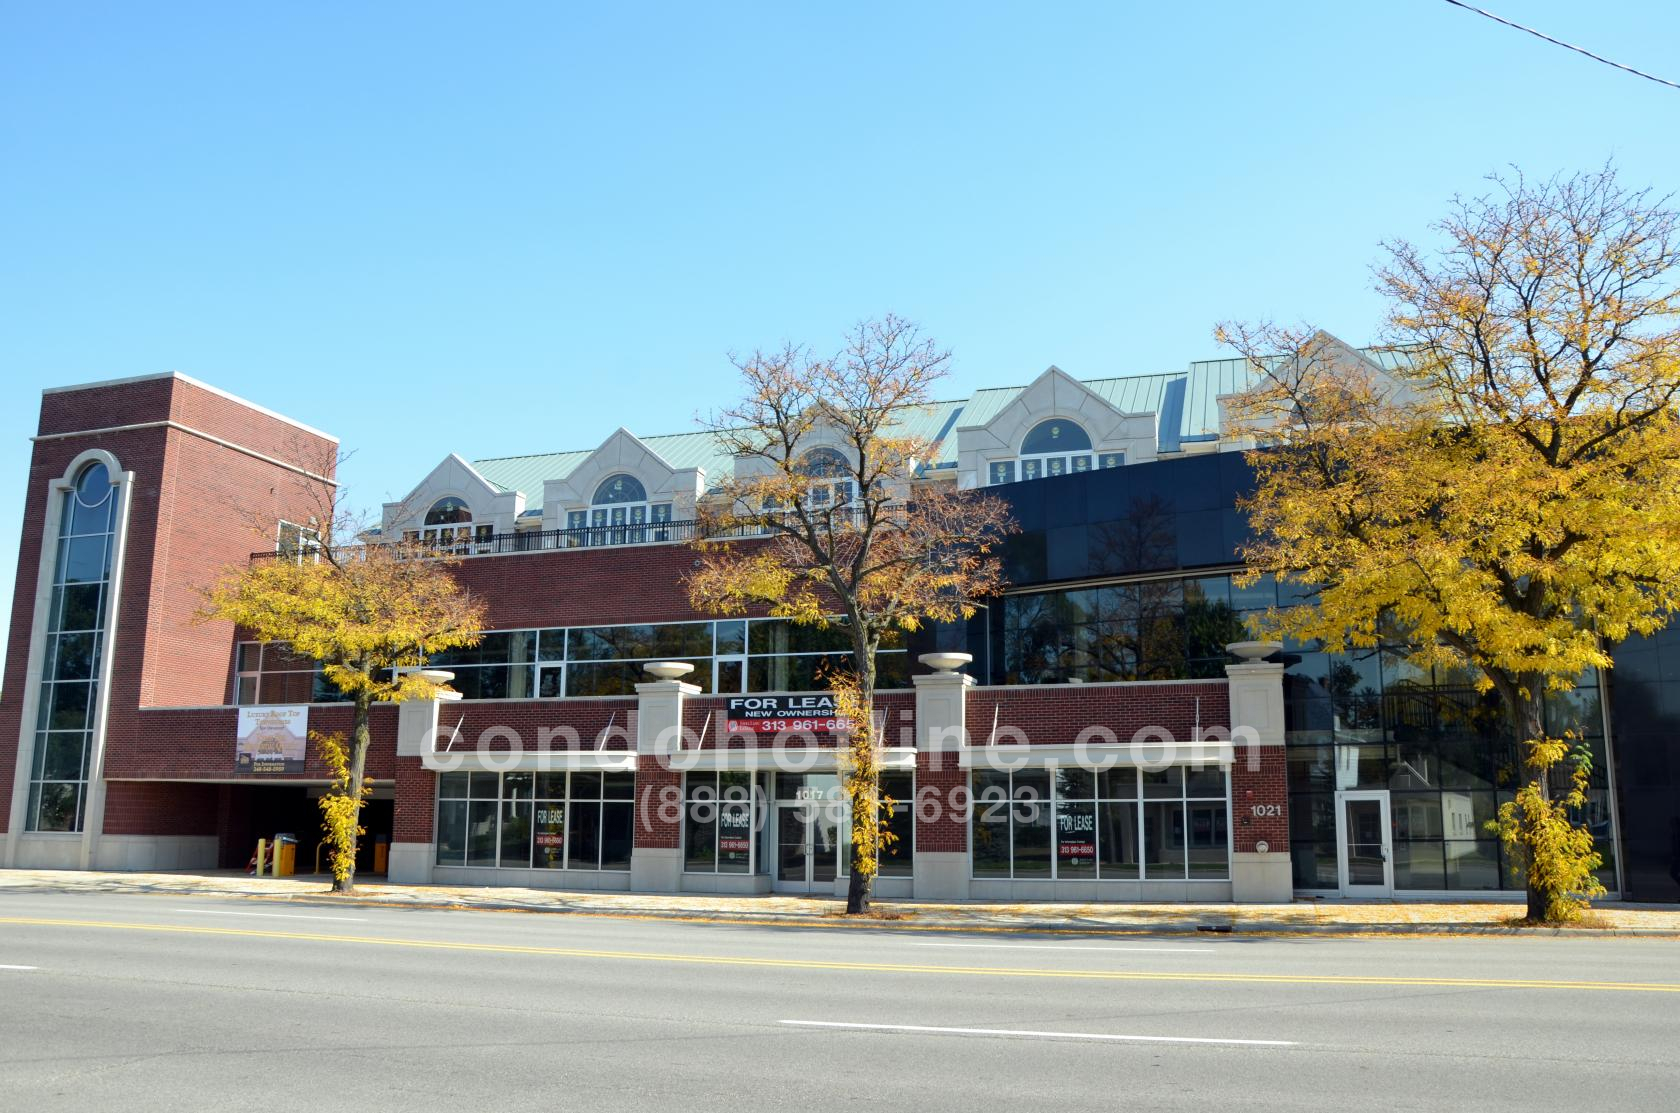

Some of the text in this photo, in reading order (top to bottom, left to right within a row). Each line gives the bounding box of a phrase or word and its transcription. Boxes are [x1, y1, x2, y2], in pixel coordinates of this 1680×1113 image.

[730, 696, 843, 710] FOR LEA
[761, 720, 787, 731] 313
[792, 719, 856, 730] 961-665
[795, 790, 824, 800] 1017
[537, 809, 563, 823] FOR LEASE
[1250, 805, 1281, 817] 1021
[720, 812, 749, 828] FOR LEASE
[1060, 815, 1093, 831] FOR LEASE
[1061, 846, 1070, 854] 313
